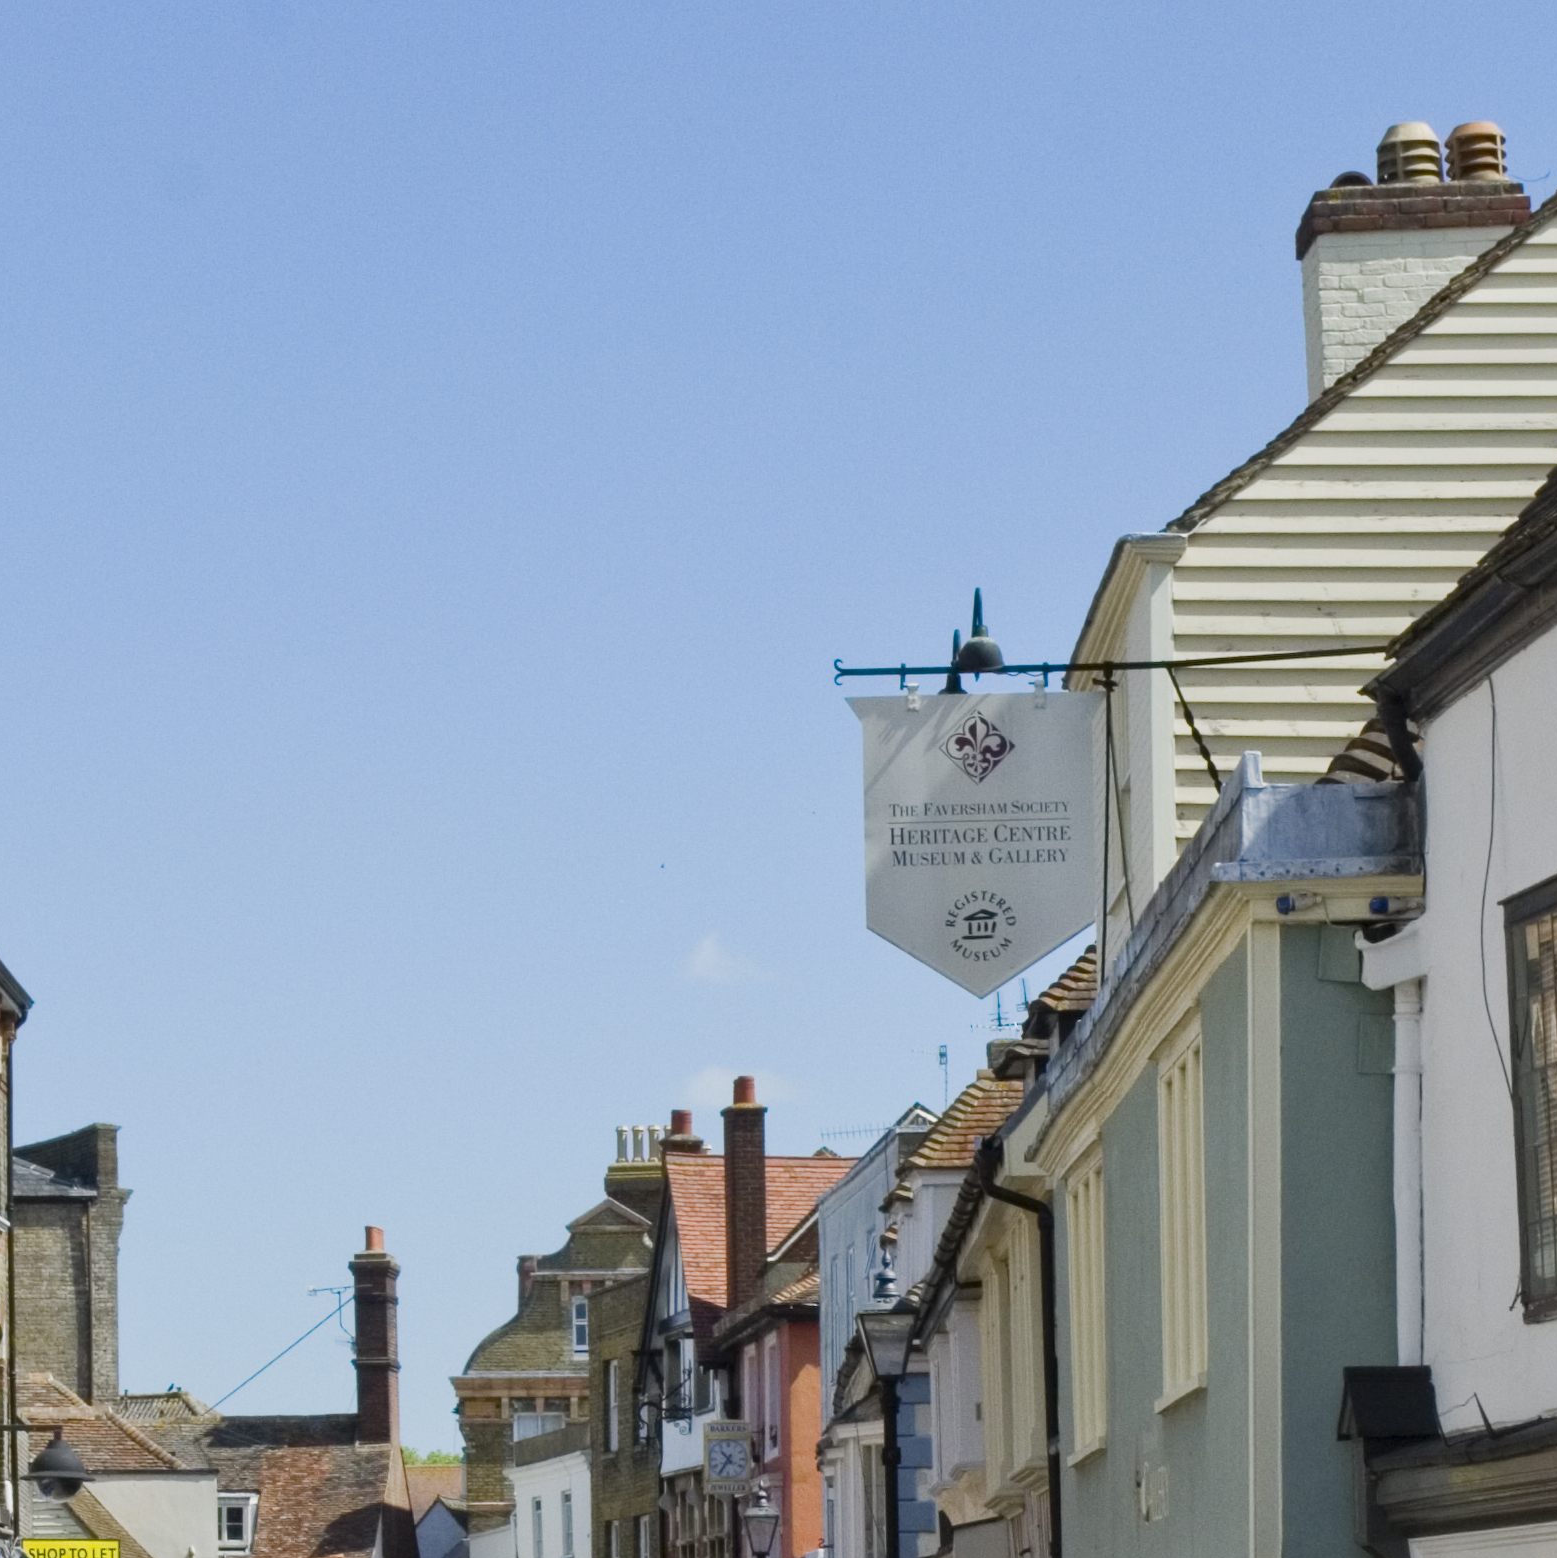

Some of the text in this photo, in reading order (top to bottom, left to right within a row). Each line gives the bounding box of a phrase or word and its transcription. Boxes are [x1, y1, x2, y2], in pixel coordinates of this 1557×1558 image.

[888, 800, 1070, 818] THE FAVERSHAM SOCIETY
[888, 825, 1072, 847] HERITAGE CENTRE
[892, 848, 1069, 868] MUSEUM & GALLERY
[944, 890, 1017, 929] REGISTERED
[950, 936, 1013, 962] MUSEUM
